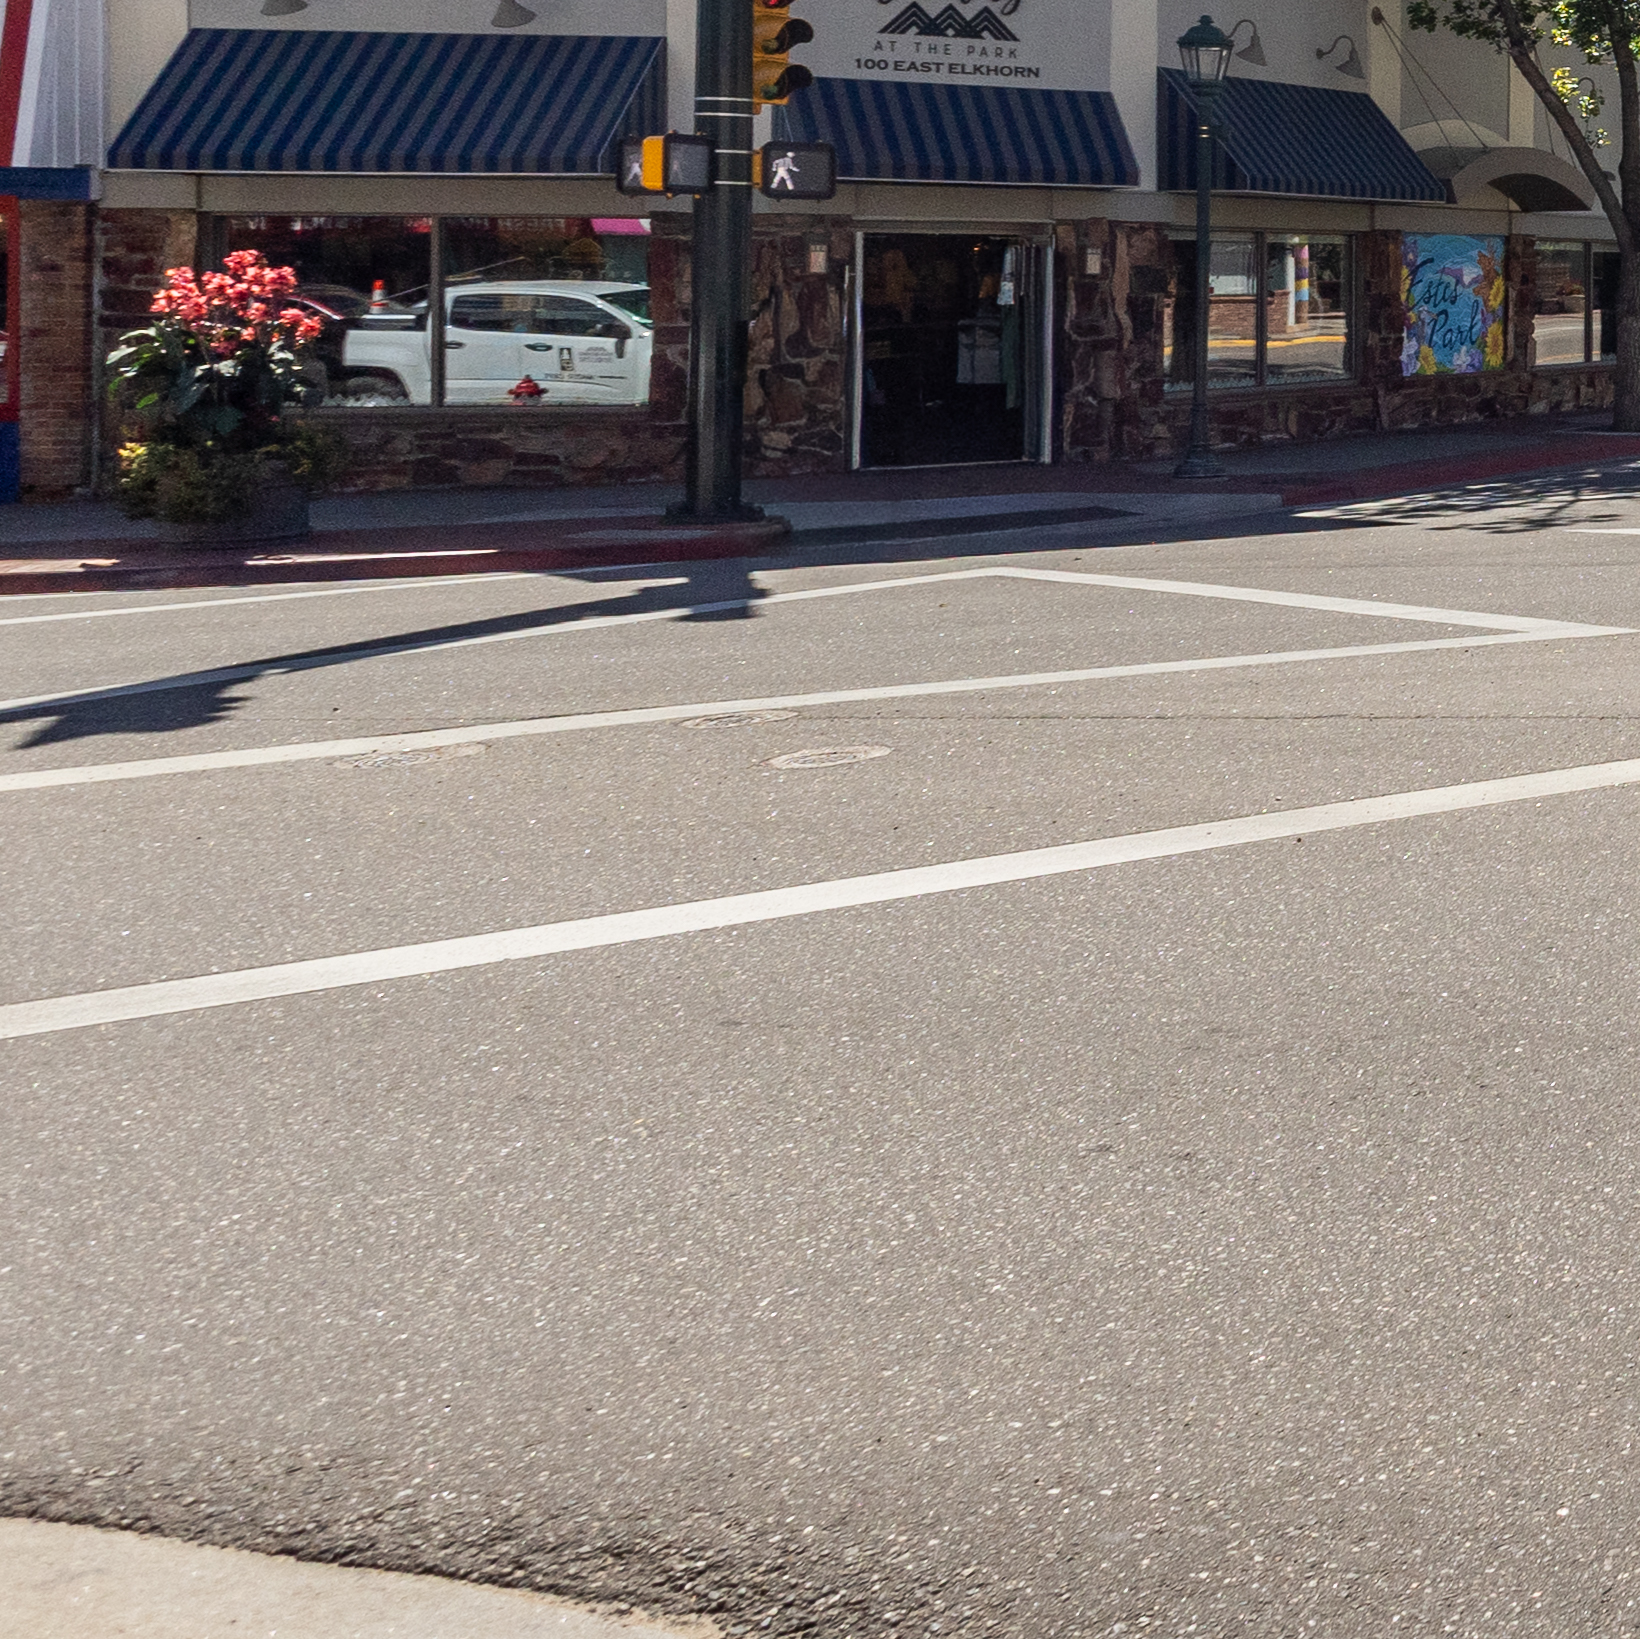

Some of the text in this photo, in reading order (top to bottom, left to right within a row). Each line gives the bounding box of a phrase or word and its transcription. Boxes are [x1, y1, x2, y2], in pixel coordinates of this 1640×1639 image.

[874, 41, 1017, 59] AT THE PARK
[855, 58, 1040, 78] 100 EAST ELKHORN
[1404, 257, 1463, 311] Estes
[1427, 299, 1480, 350] Park
